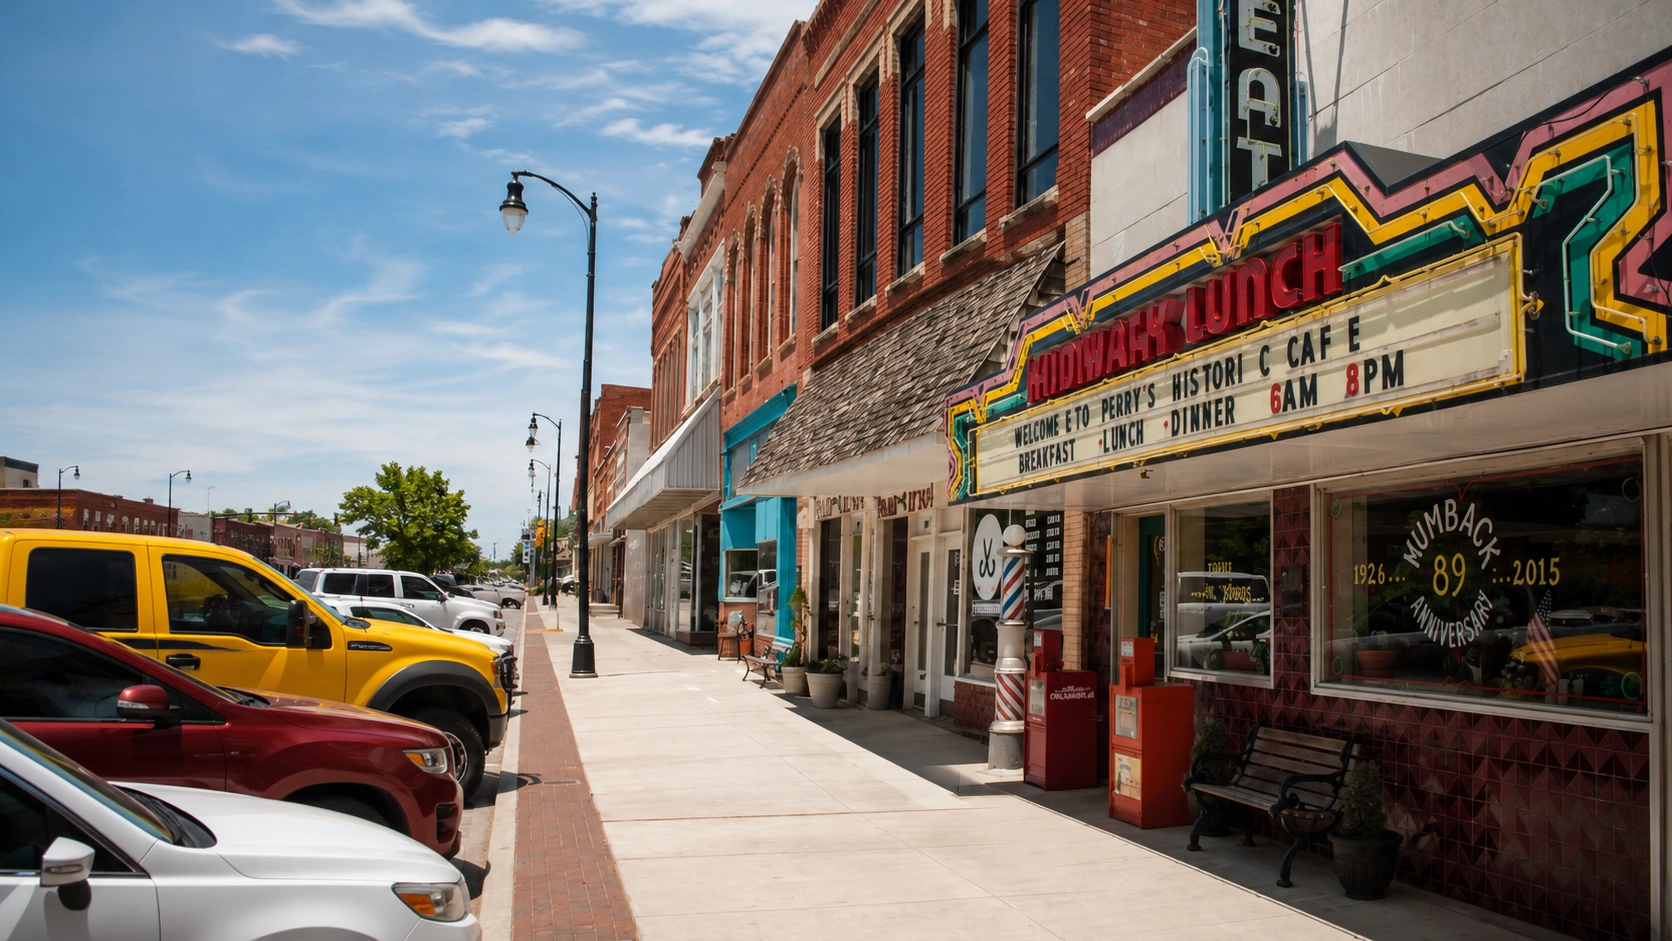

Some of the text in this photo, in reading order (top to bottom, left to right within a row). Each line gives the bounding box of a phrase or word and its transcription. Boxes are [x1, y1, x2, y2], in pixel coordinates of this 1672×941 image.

[1015, 414, 1059, 448] WELCOME
[1101, 383, 1156, 422] PERRY'S
[1018, 349, 1405, 474] BREAKFAST LUNCH DINNER 6AM 8PM
[1403, 498, 1501, 570] MUMBACK
[1432, 552, 1466, 597] 89
[1410, 589, 1493, 648] ANNIVERSARY
